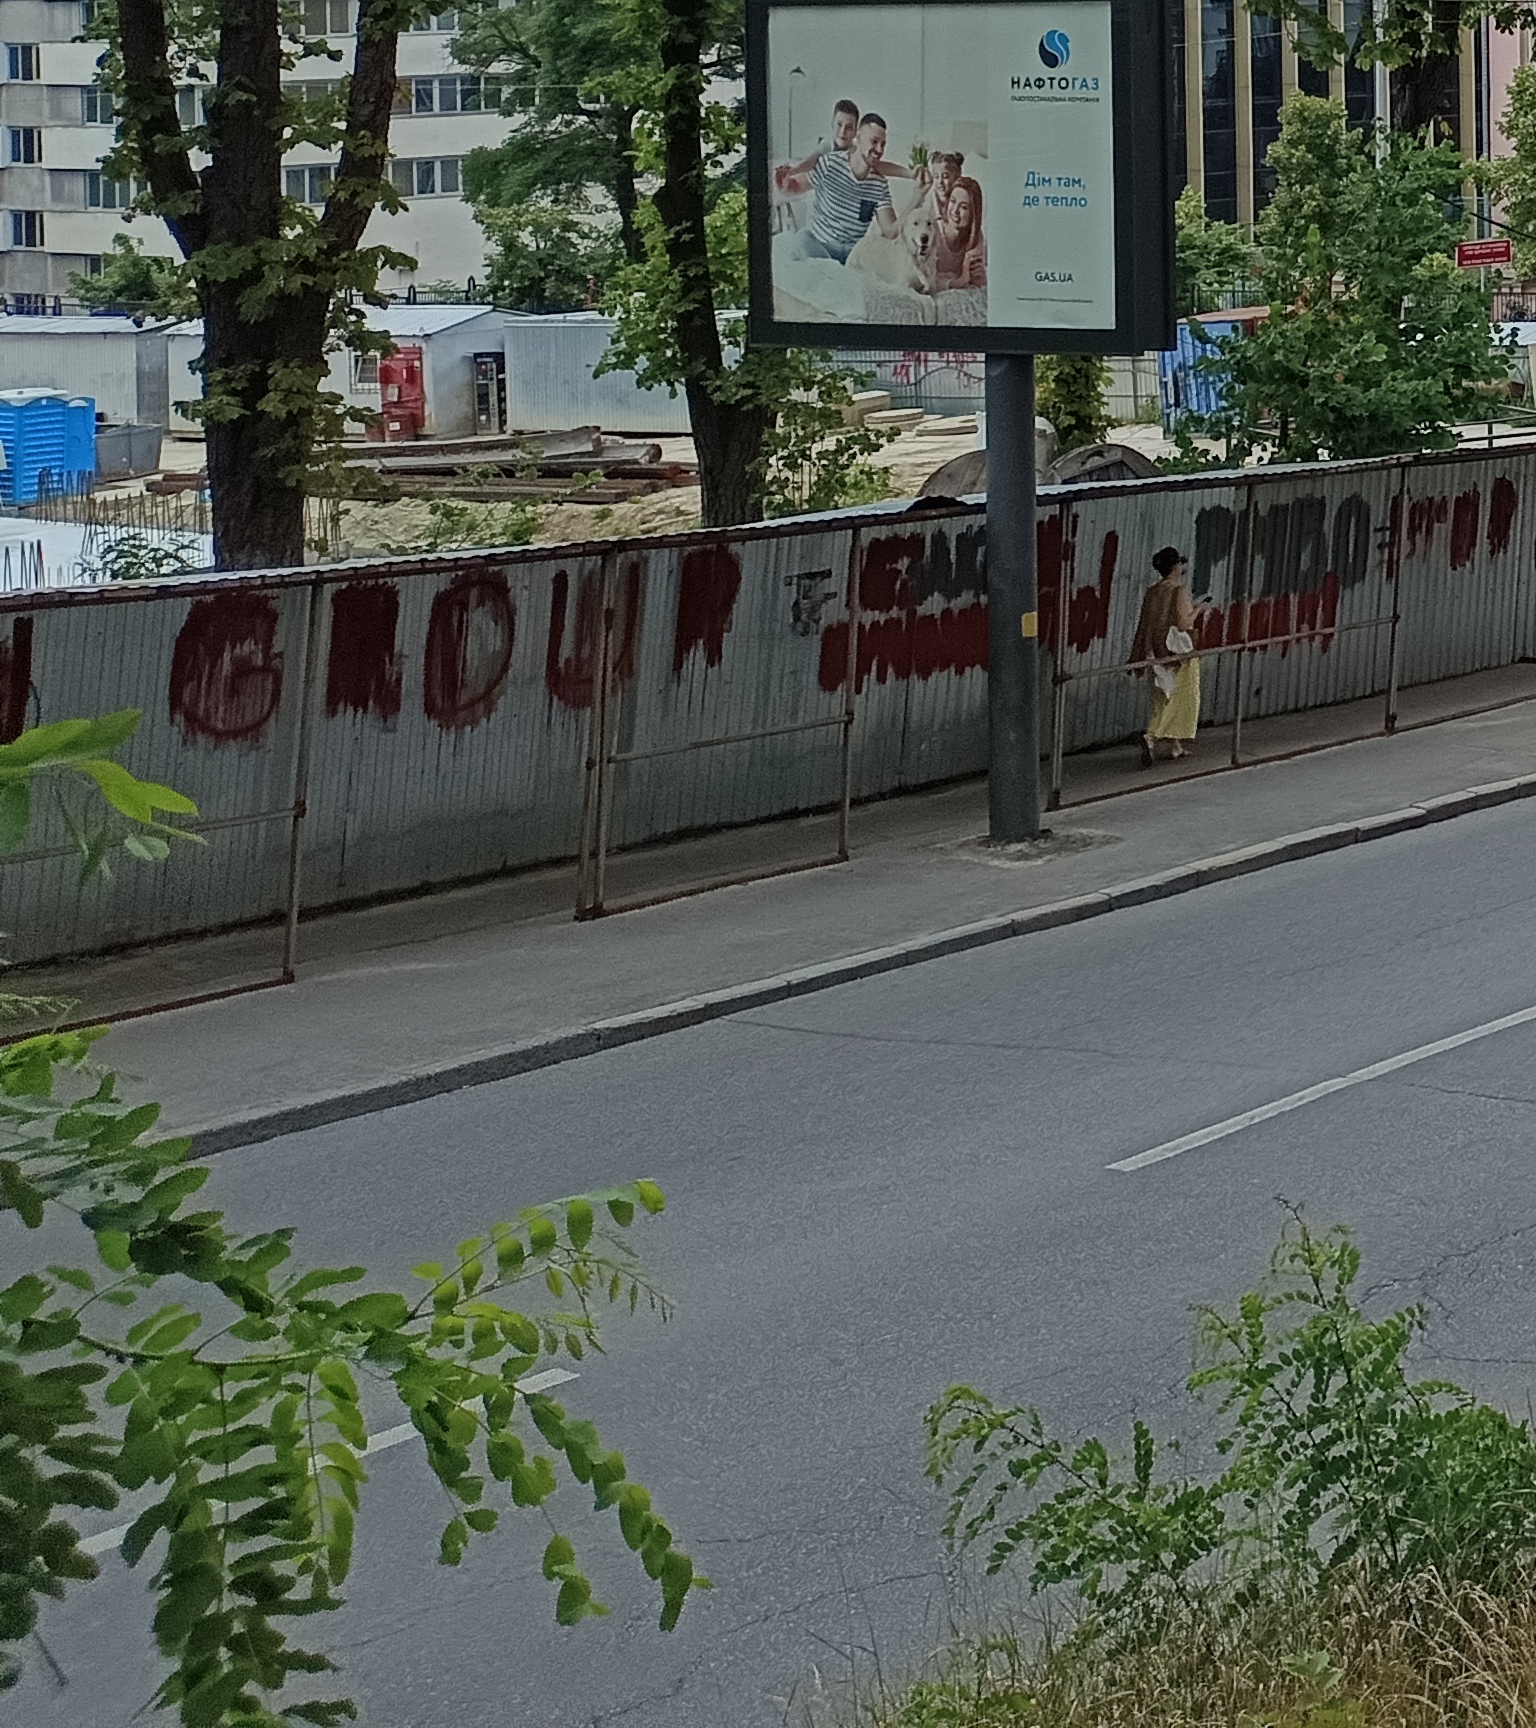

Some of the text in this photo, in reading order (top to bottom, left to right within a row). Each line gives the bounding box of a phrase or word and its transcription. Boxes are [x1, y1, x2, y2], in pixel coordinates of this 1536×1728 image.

[1010, 76, 1100, 91] НАФТОГАЗ
[1025, 171, 1086, 191] Дім там,
[1023, 196, 1087, 208] де тепло
[1034, 272, 1074, 283] GAS.UA
